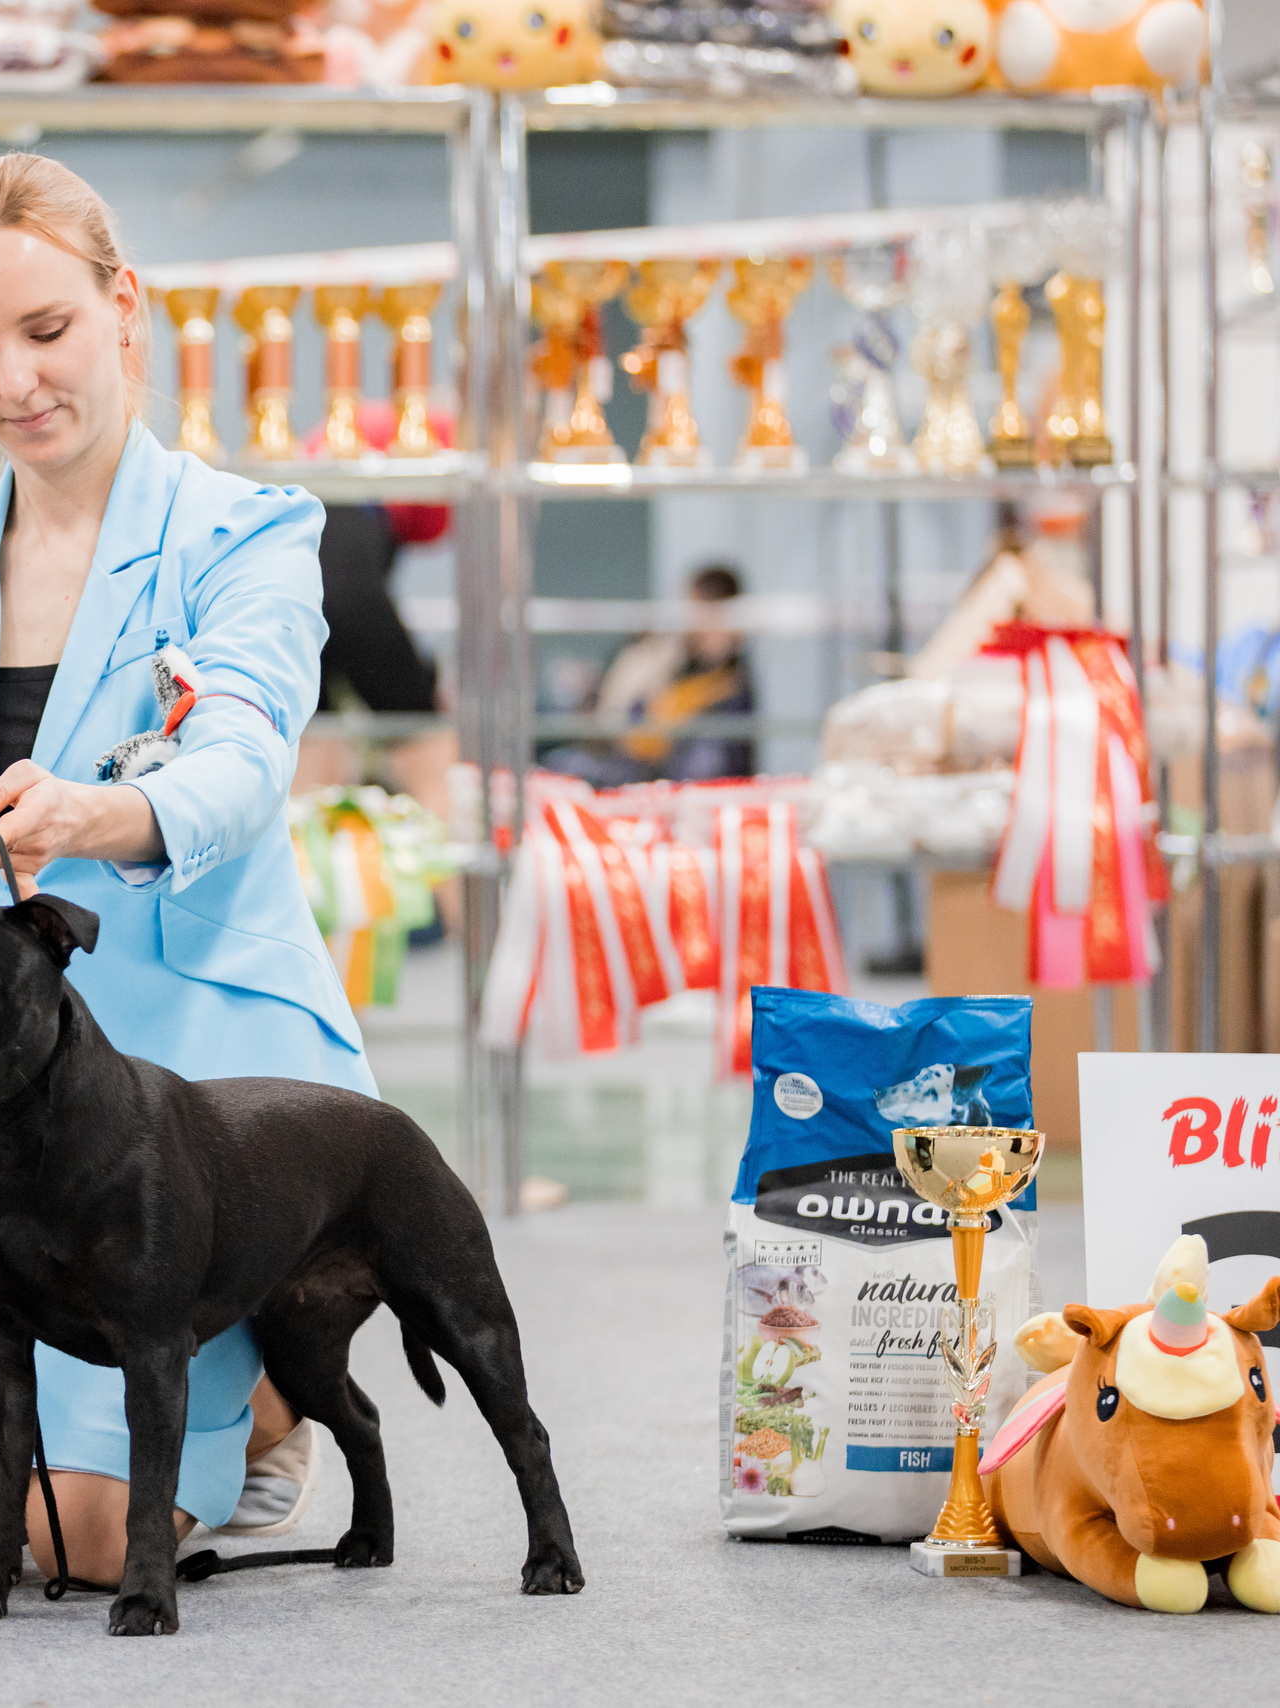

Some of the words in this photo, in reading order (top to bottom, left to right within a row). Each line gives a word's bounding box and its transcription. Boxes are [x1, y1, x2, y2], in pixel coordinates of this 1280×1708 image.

[1161, 1095, 1280, 1172] Bli
[829, 1169, 857, 1185] THE
[861, 1172, 897, 1188] REAL
[797, 1193, 946, 1226] owna
[849, 1224, 908, 1237] Classic
[758, 1253, 819, 1265] INGREDIENTS
[857, 1273, 959, 1305] natura
[850, 1331, 876, 1347] and
[876, 1330, 925, 1359] fresh
[848, 1403, 878, 1412] PULSES
[889, 1404, 938, 1414] LEGUMBRES
[848, 1418, 867, 1426] FRESH
[868, 1419, 886, 1427] FRUIT
[899, 1450, 931, 1468] FISH
[964, 1556, 986, 1564] BIS-3
